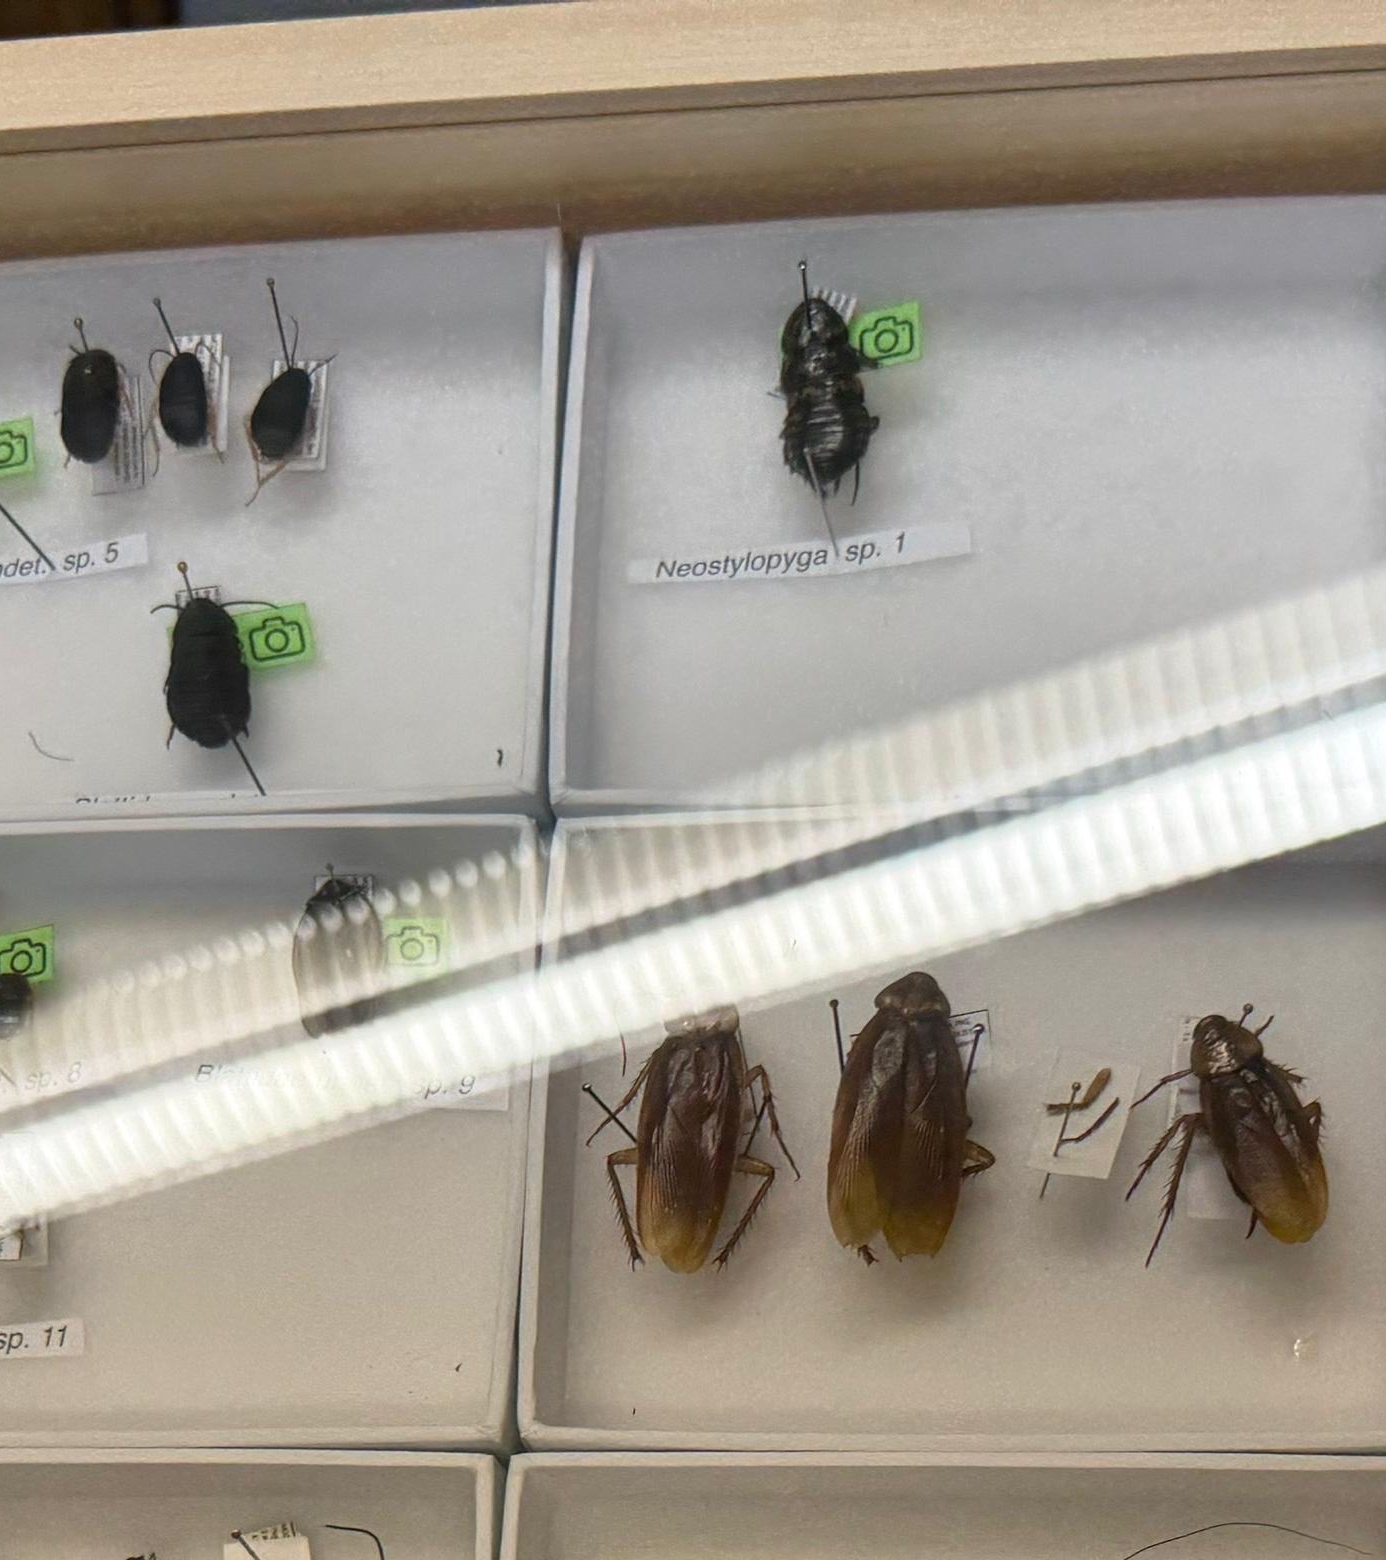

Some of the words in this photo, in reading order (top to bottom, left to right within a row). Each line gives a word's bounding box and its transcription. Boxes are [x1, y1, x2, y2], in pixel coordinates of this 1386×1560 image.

[63, 553, 95, 574] sp.
[104, 542, 120, 563] 5
[655, 549, 828, 579] Neostylopyga
[844, 542, 881, 565] sp.
[895, 531, 906, 554] 1
[24, 1071, 59, 1093] sp.
[67, 1061, 83, 1084] 8
[458, 1073, 477, 1096] 9
[43, 1325, 68, 1347] 11
